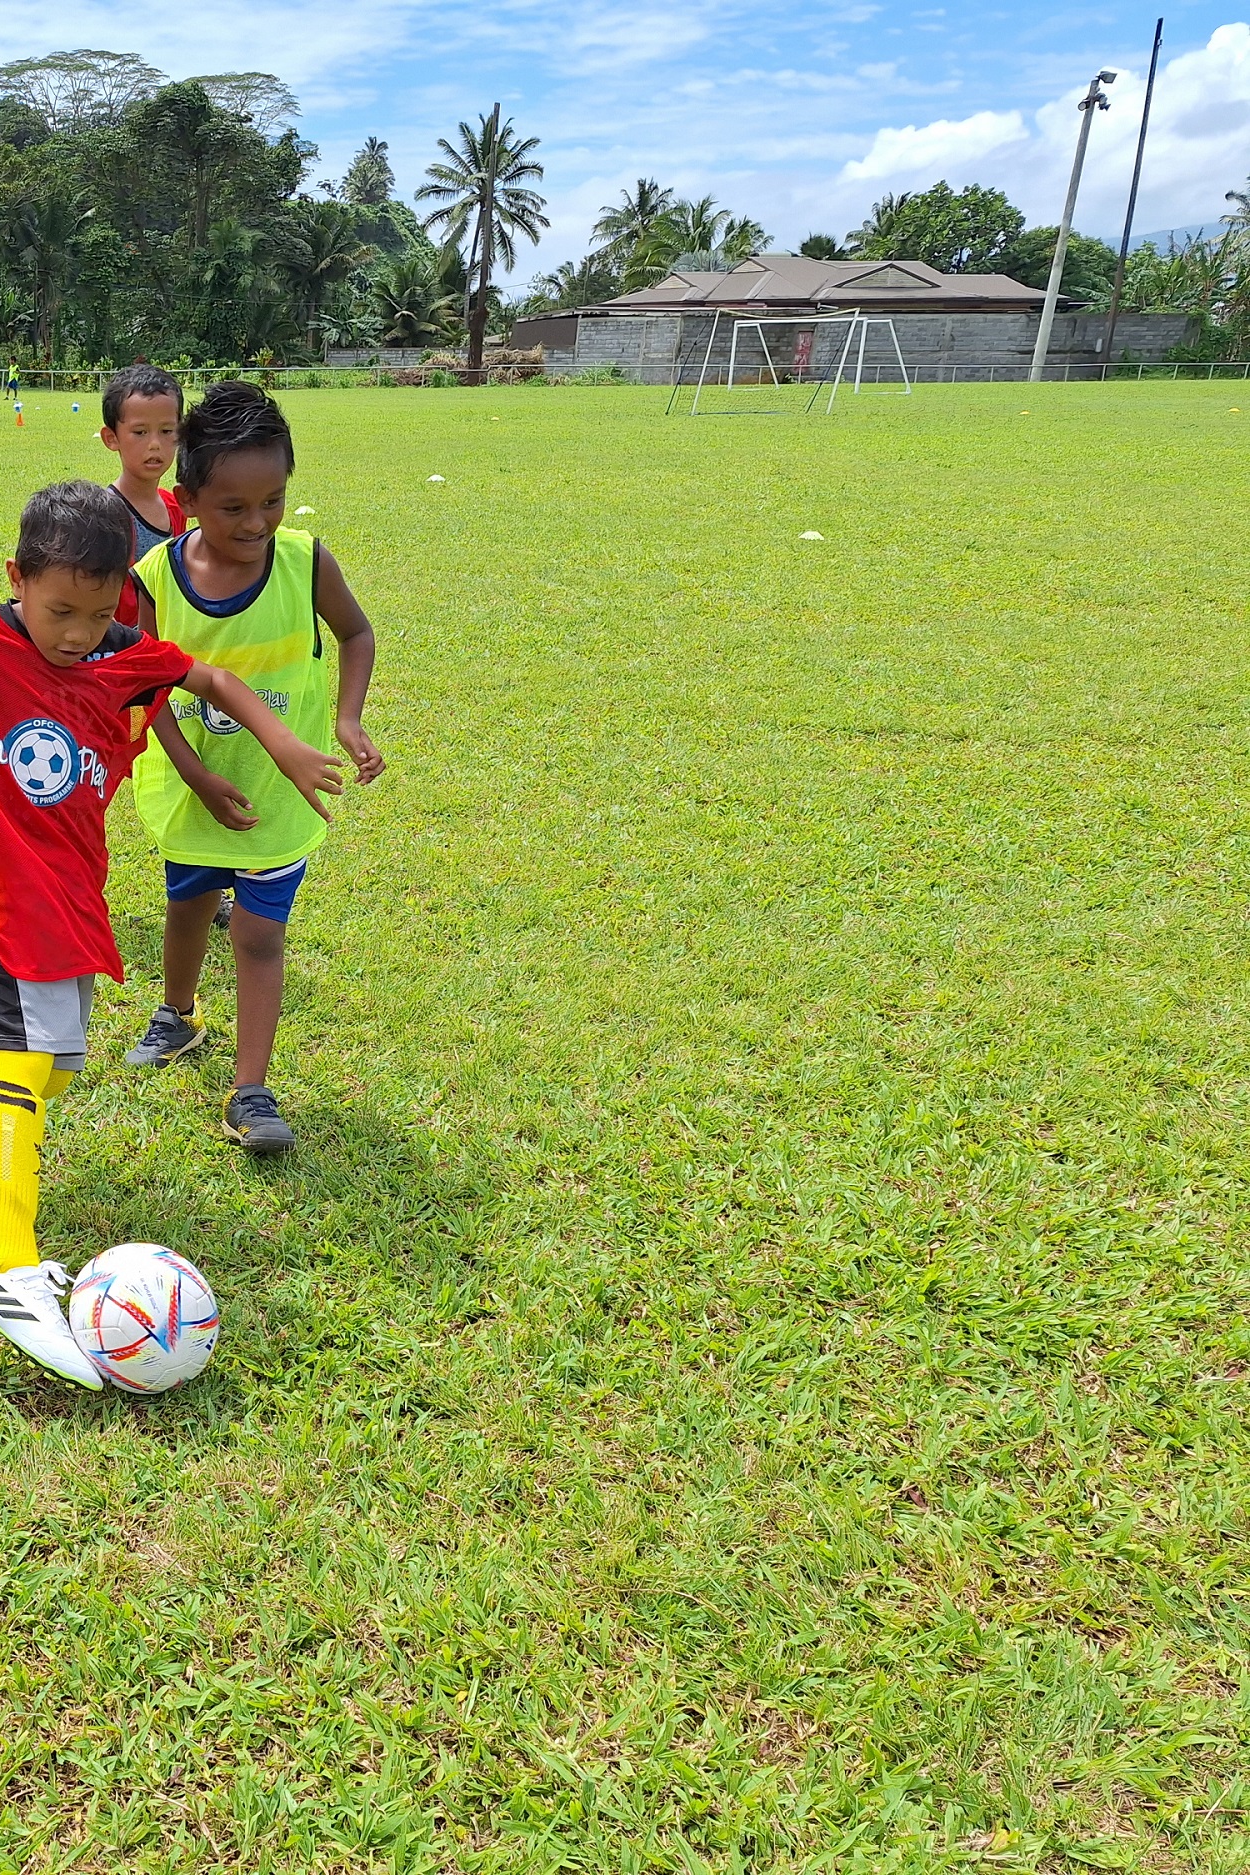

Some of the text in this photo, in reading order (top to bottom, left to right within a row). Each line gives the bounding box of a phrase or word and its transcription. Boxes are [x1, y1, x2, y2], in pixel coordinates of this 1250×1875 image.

[32, 719, 55, 729] OFC
[78, 746, 108, 799] Play
[39, 778, 75, 804] PROGRAMME
